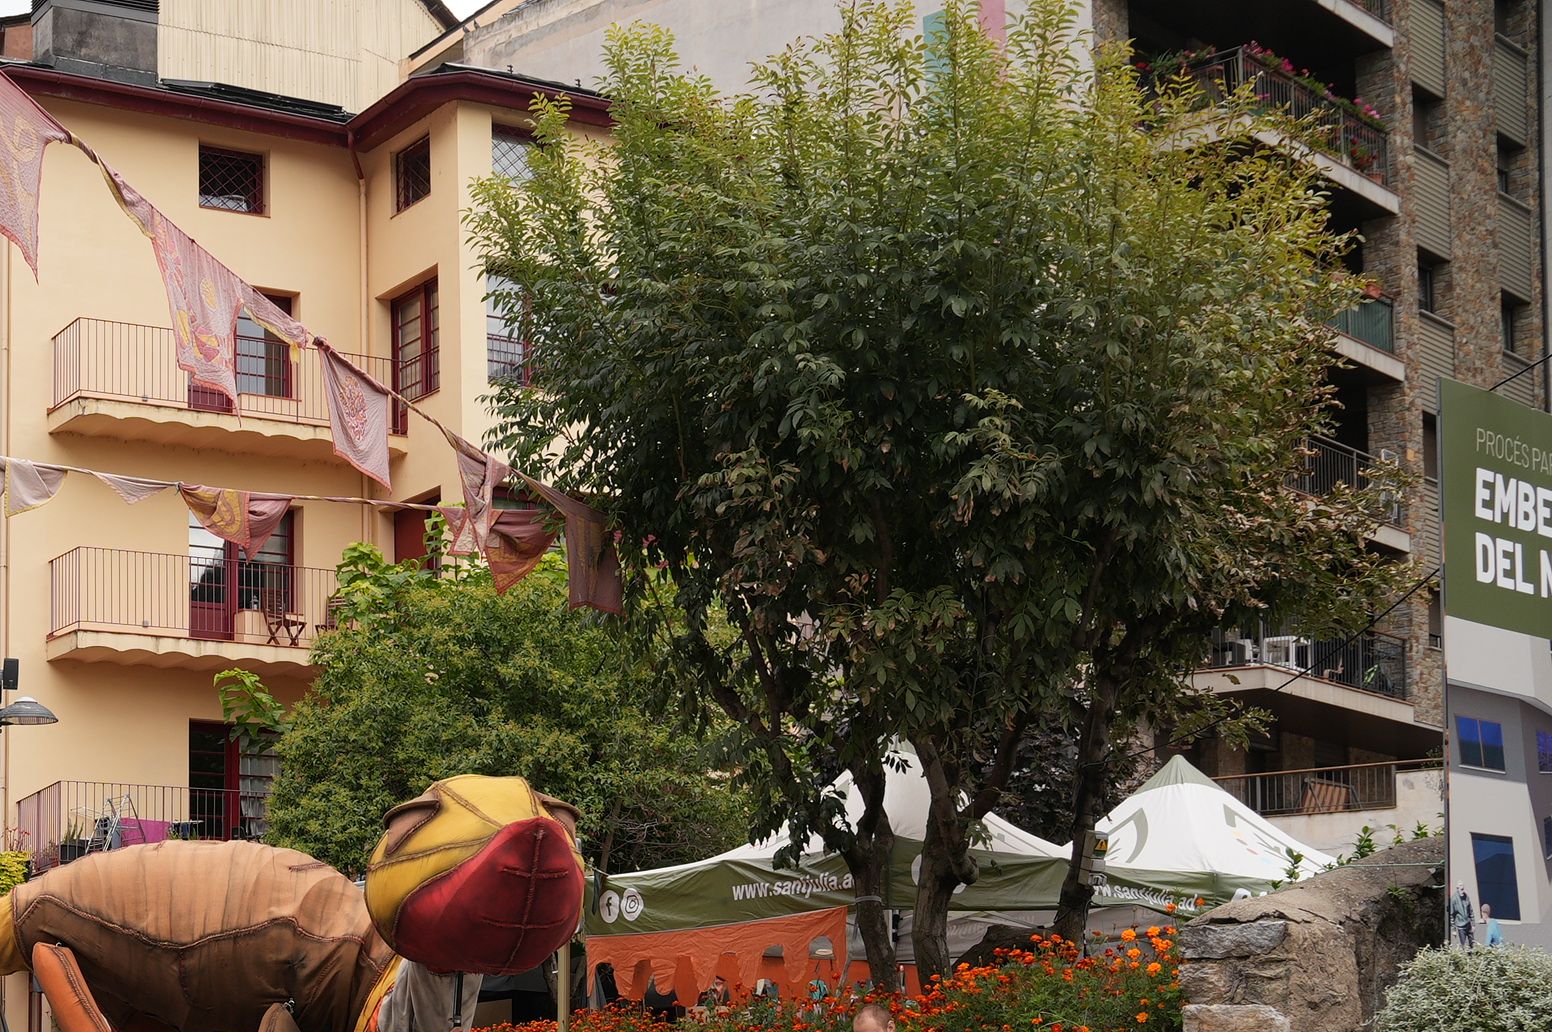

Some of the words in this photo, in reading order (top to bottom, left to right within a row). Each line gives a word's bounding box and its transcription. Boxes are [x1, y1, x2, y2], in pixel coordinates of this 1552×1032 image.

[1476, 427, 1529, 468] PROCÉS
[1475, 532, 1534, 595] DEL
[732, 872, 855, 900] www.santjulia.a
